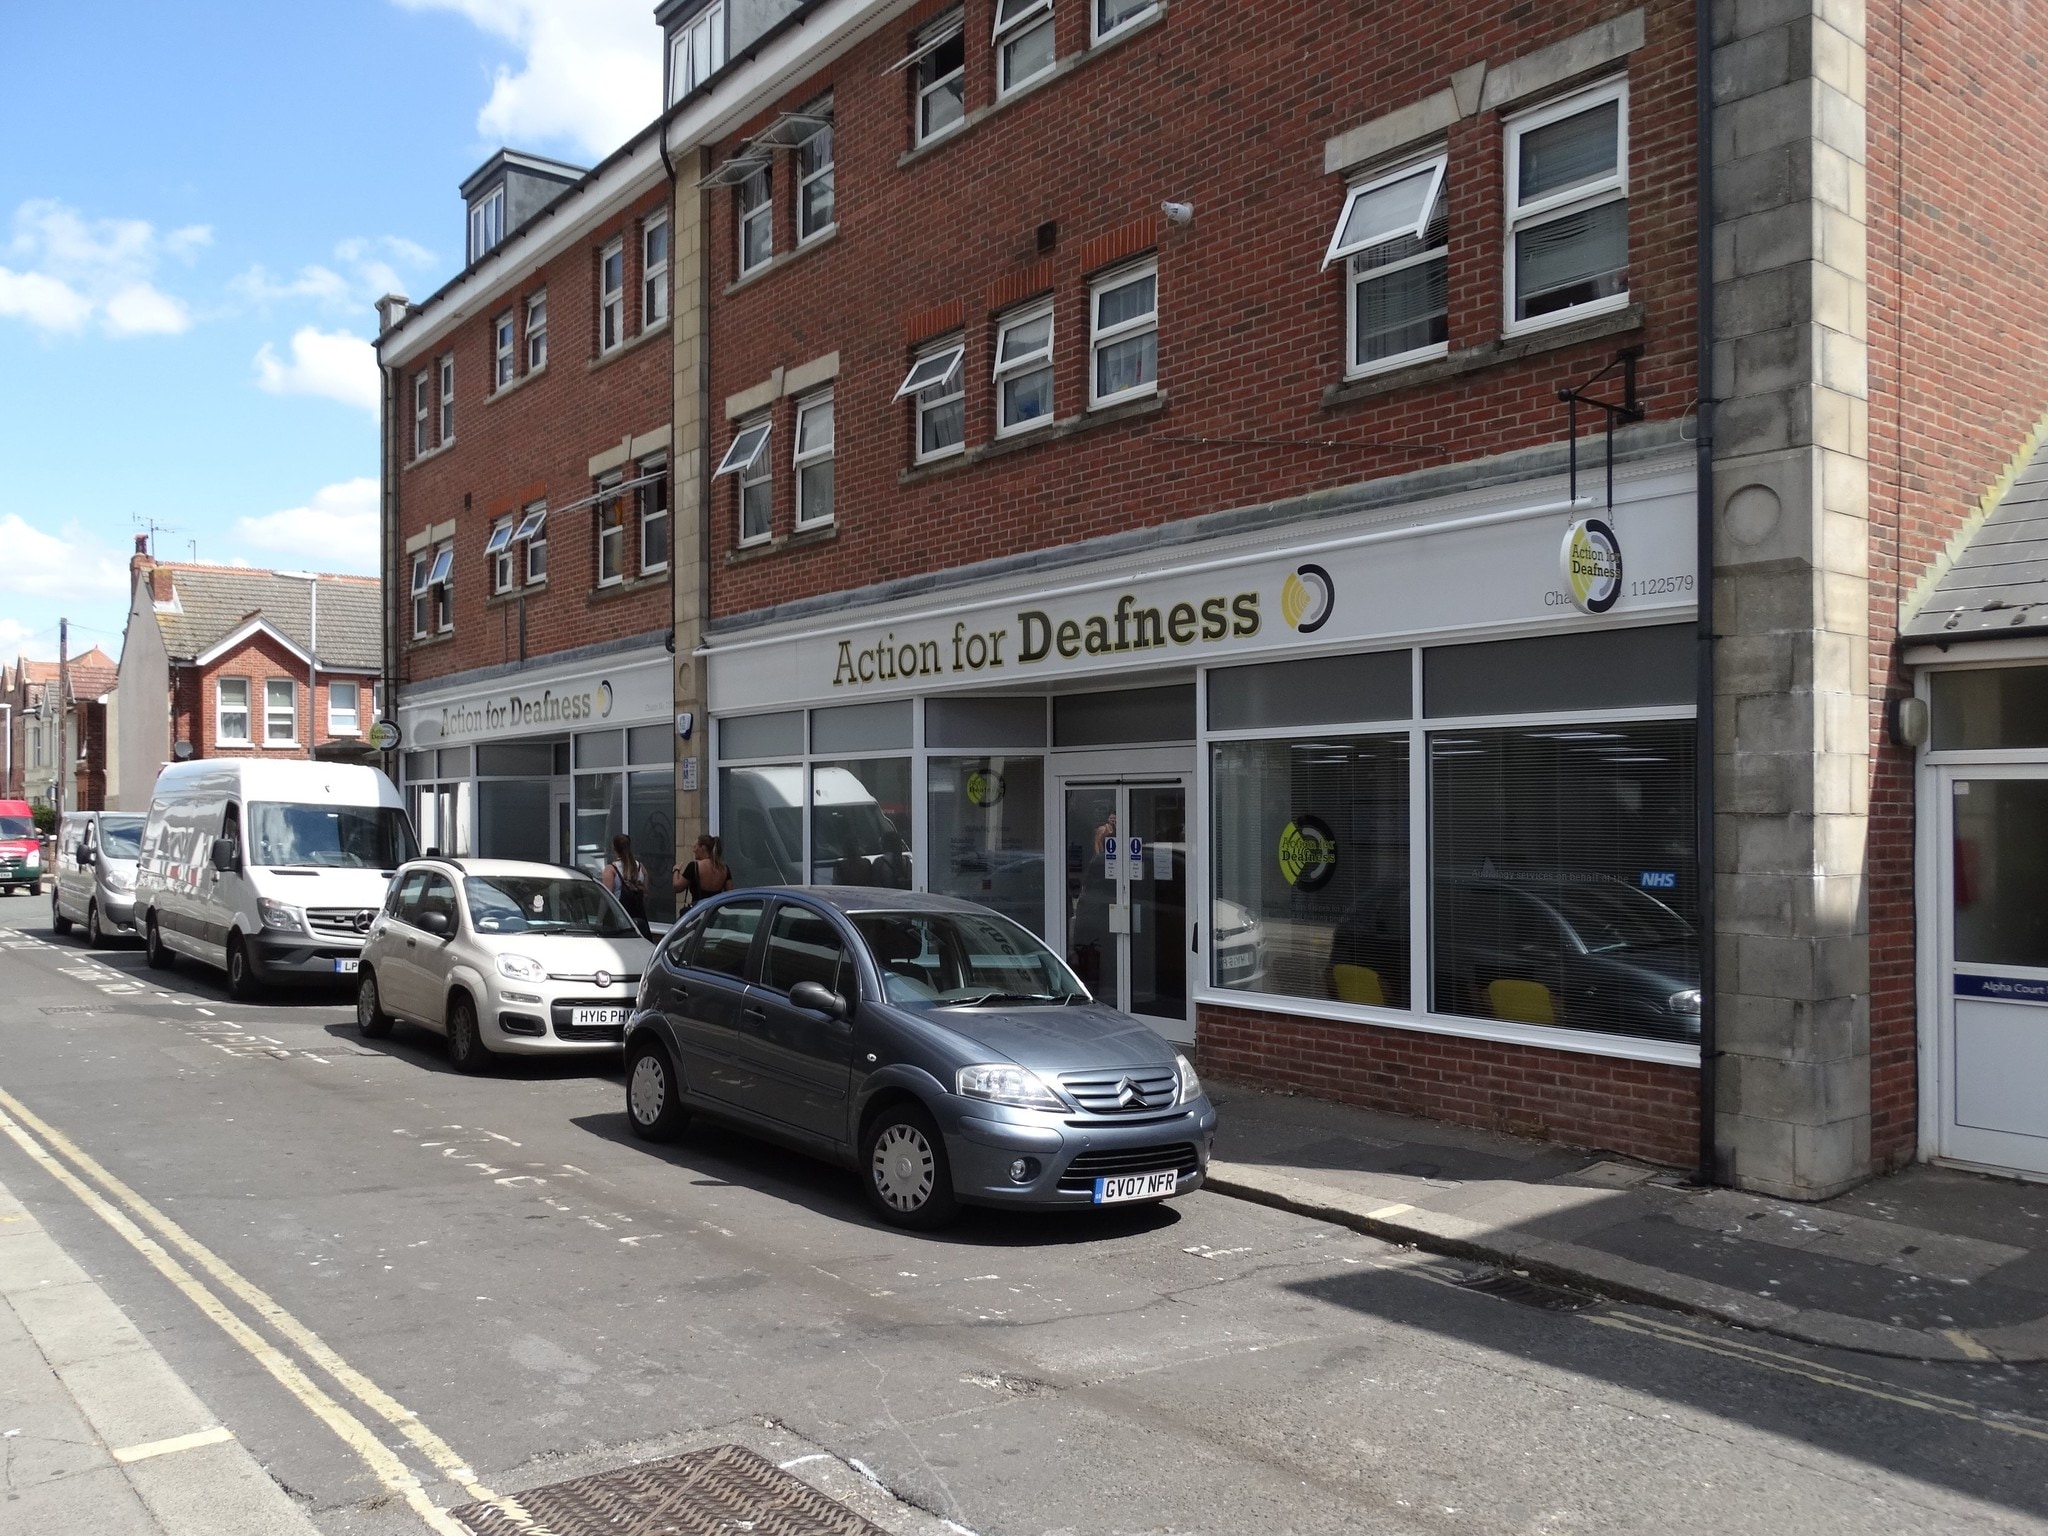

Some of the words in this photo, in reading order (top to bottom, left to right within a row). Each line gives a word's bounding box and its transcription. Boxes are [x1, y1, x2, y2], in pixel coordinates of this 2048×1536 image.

[1572, 544, 1604, 562] Action
[1572, 560, 1621, 580] Deafness
[1632, 574, 1694, 596] 1122579
[832, 633, 942, 687] Action
[952, 621, 1008, 672] for
[1016, 591, 1262, 664] Deafness
[440, 705, 484, 738] Action
[485, 700, 507, 730] for
[509, 689, 592, 727] Deafness
[1282, 837, 1317, 850] Action
[1282, 848, 1336, 864] Deafness
[1641, 872, 1675, 887] NHS
[1982, 981, 2012, 993] Alpha
[2013, 983, 2045, 995] Court
[580, 1010, 608, 1022] HY16
[1106, 1177, 1146, 1198] GV07
[1147, 1173, 1175, 1194] NFR
